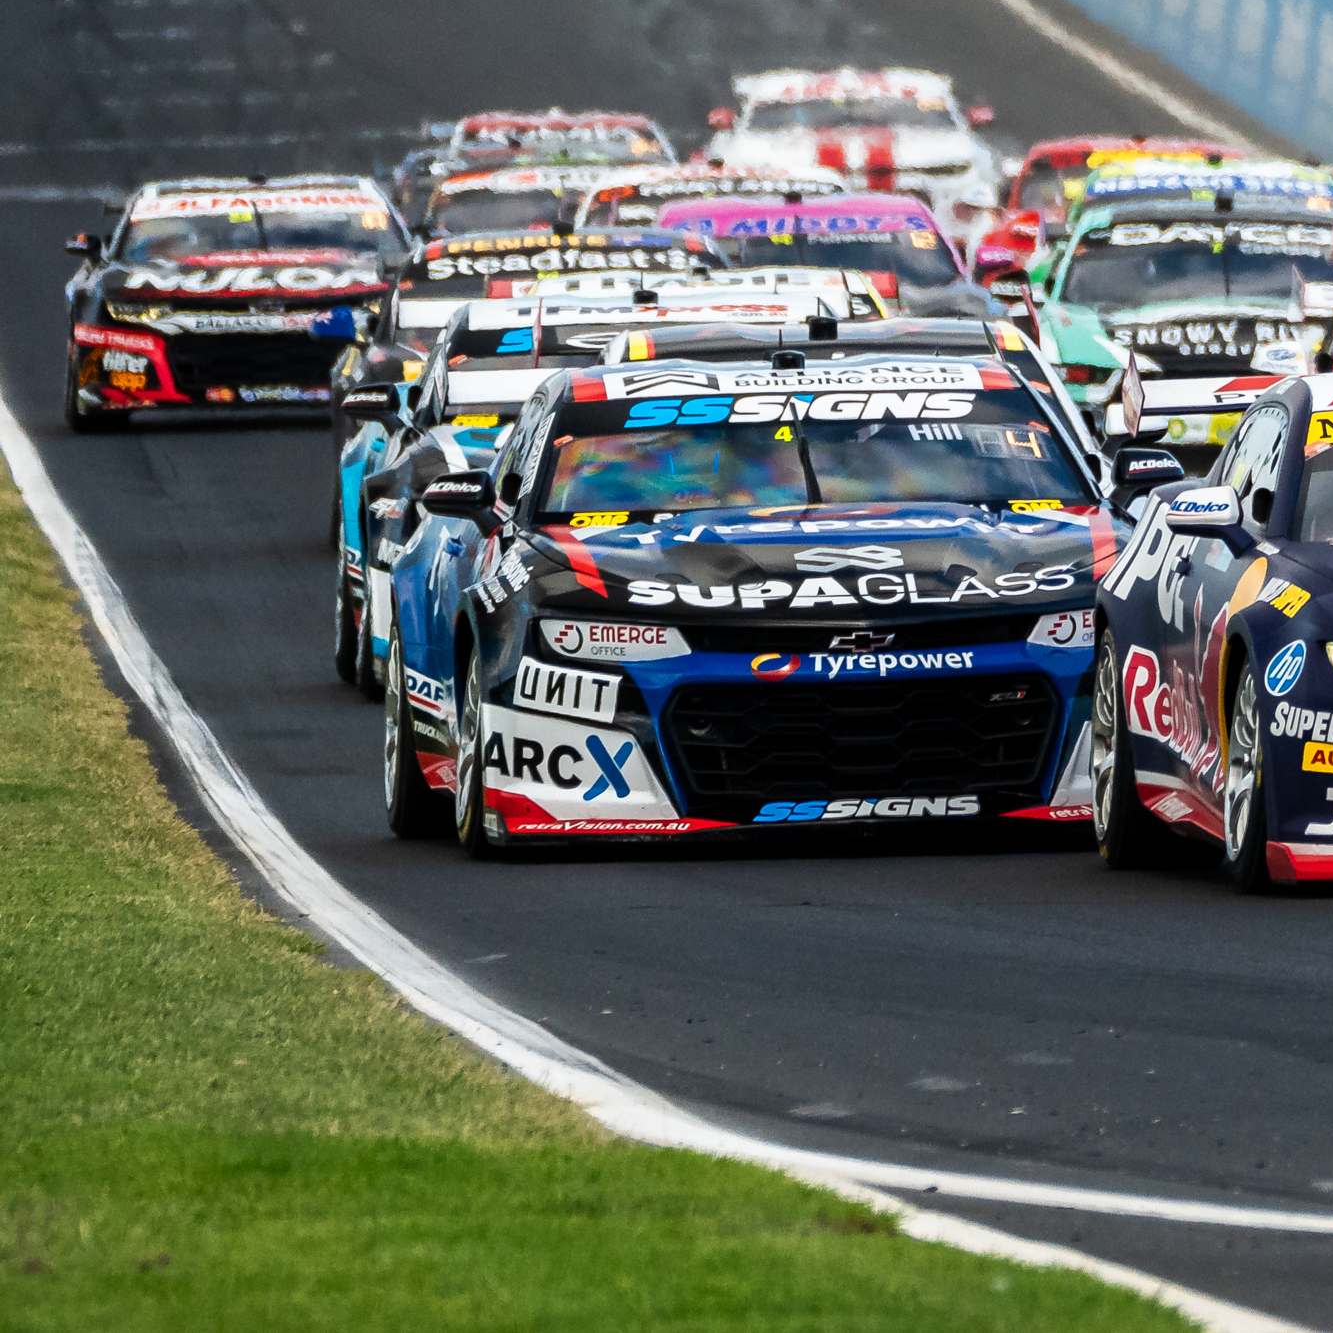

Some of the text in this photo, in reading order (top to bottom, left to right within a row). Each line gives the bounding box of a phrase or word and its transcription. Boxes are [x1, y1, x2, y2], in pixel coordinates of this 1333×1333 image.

[735, 375, 965, 388] BUILDING GROUP
[774, 426, 793, 442] 4
[908, 424, 964, 442] Hill
[427, 481, 482, 493] ACDelco
[1170, 500, 1230, 513] ACDelco
[570, 511, 630, 528] OMP
[588, 625, 668, 645] EMERGE
[591, 646, 626, 657] OFFICE
[809, 649, 974, 679] Tyrepower
